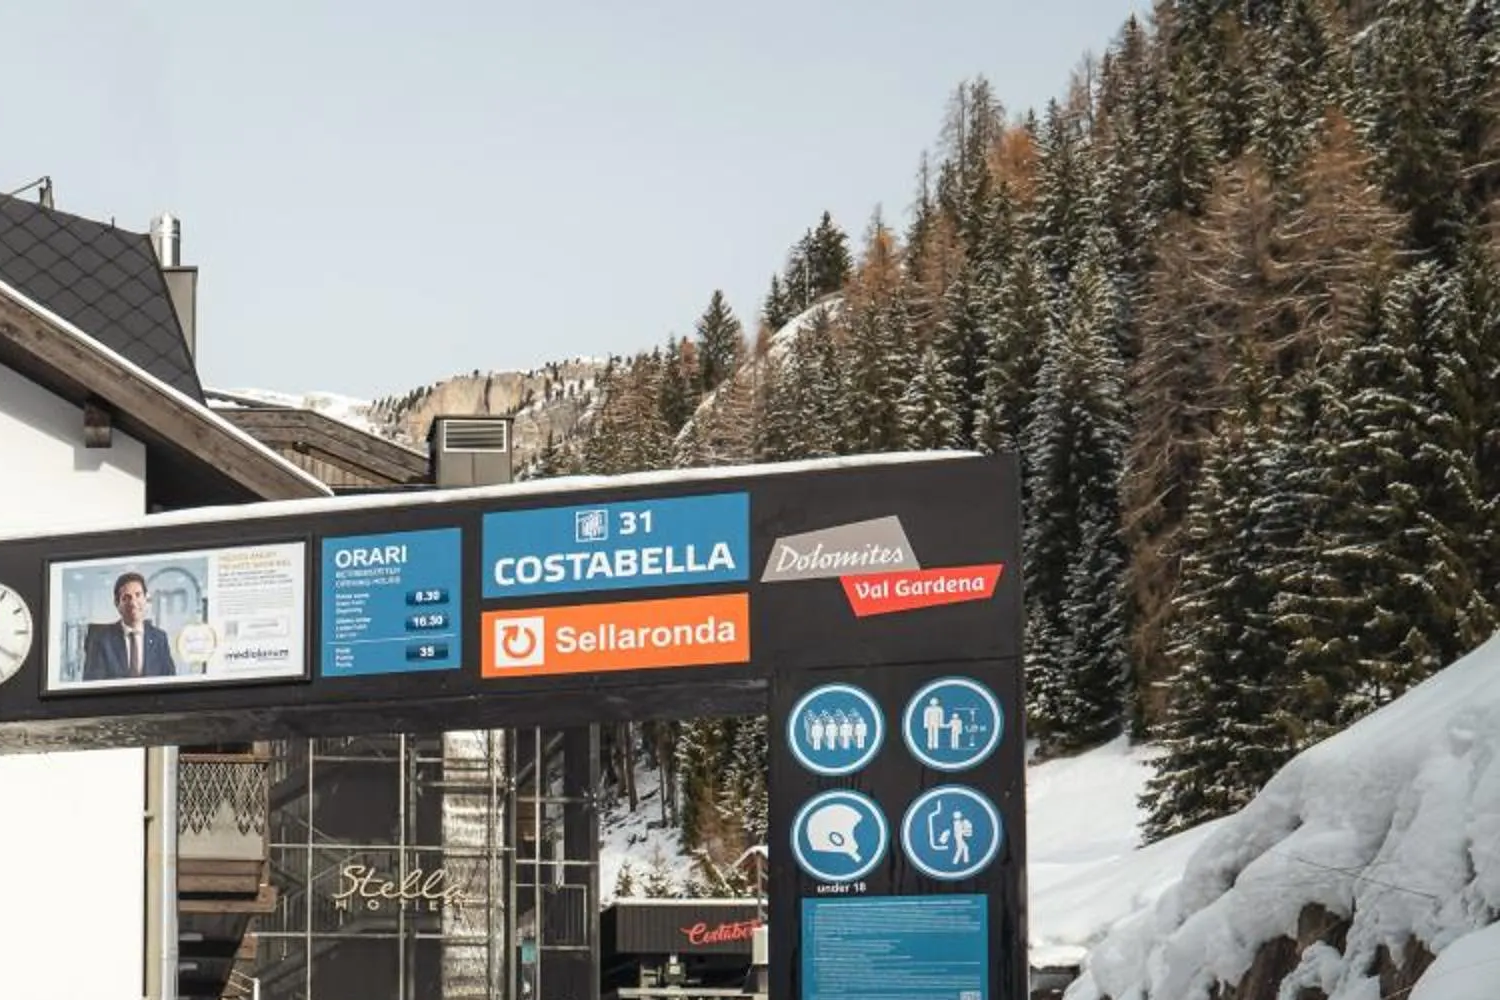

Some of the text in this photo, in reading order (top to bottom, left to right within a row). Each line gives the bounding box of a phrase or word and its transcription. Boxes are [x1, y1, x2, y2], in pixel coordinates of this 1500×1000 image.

[619, 510, 652, 535] 31
[335, 544, 408, 568] ORARI
[494, 541, 736, 586] COSTABELLA
[775, 543, 905, 573] Dolomites
[853, 575, 985, 600] Val Gardena
[555, 616, 736, 654] Sellaronda
[419, 645, 435, 657] 35
[332, 864, 469, 899] Stella
[817, 881, 867, 893] under 18
